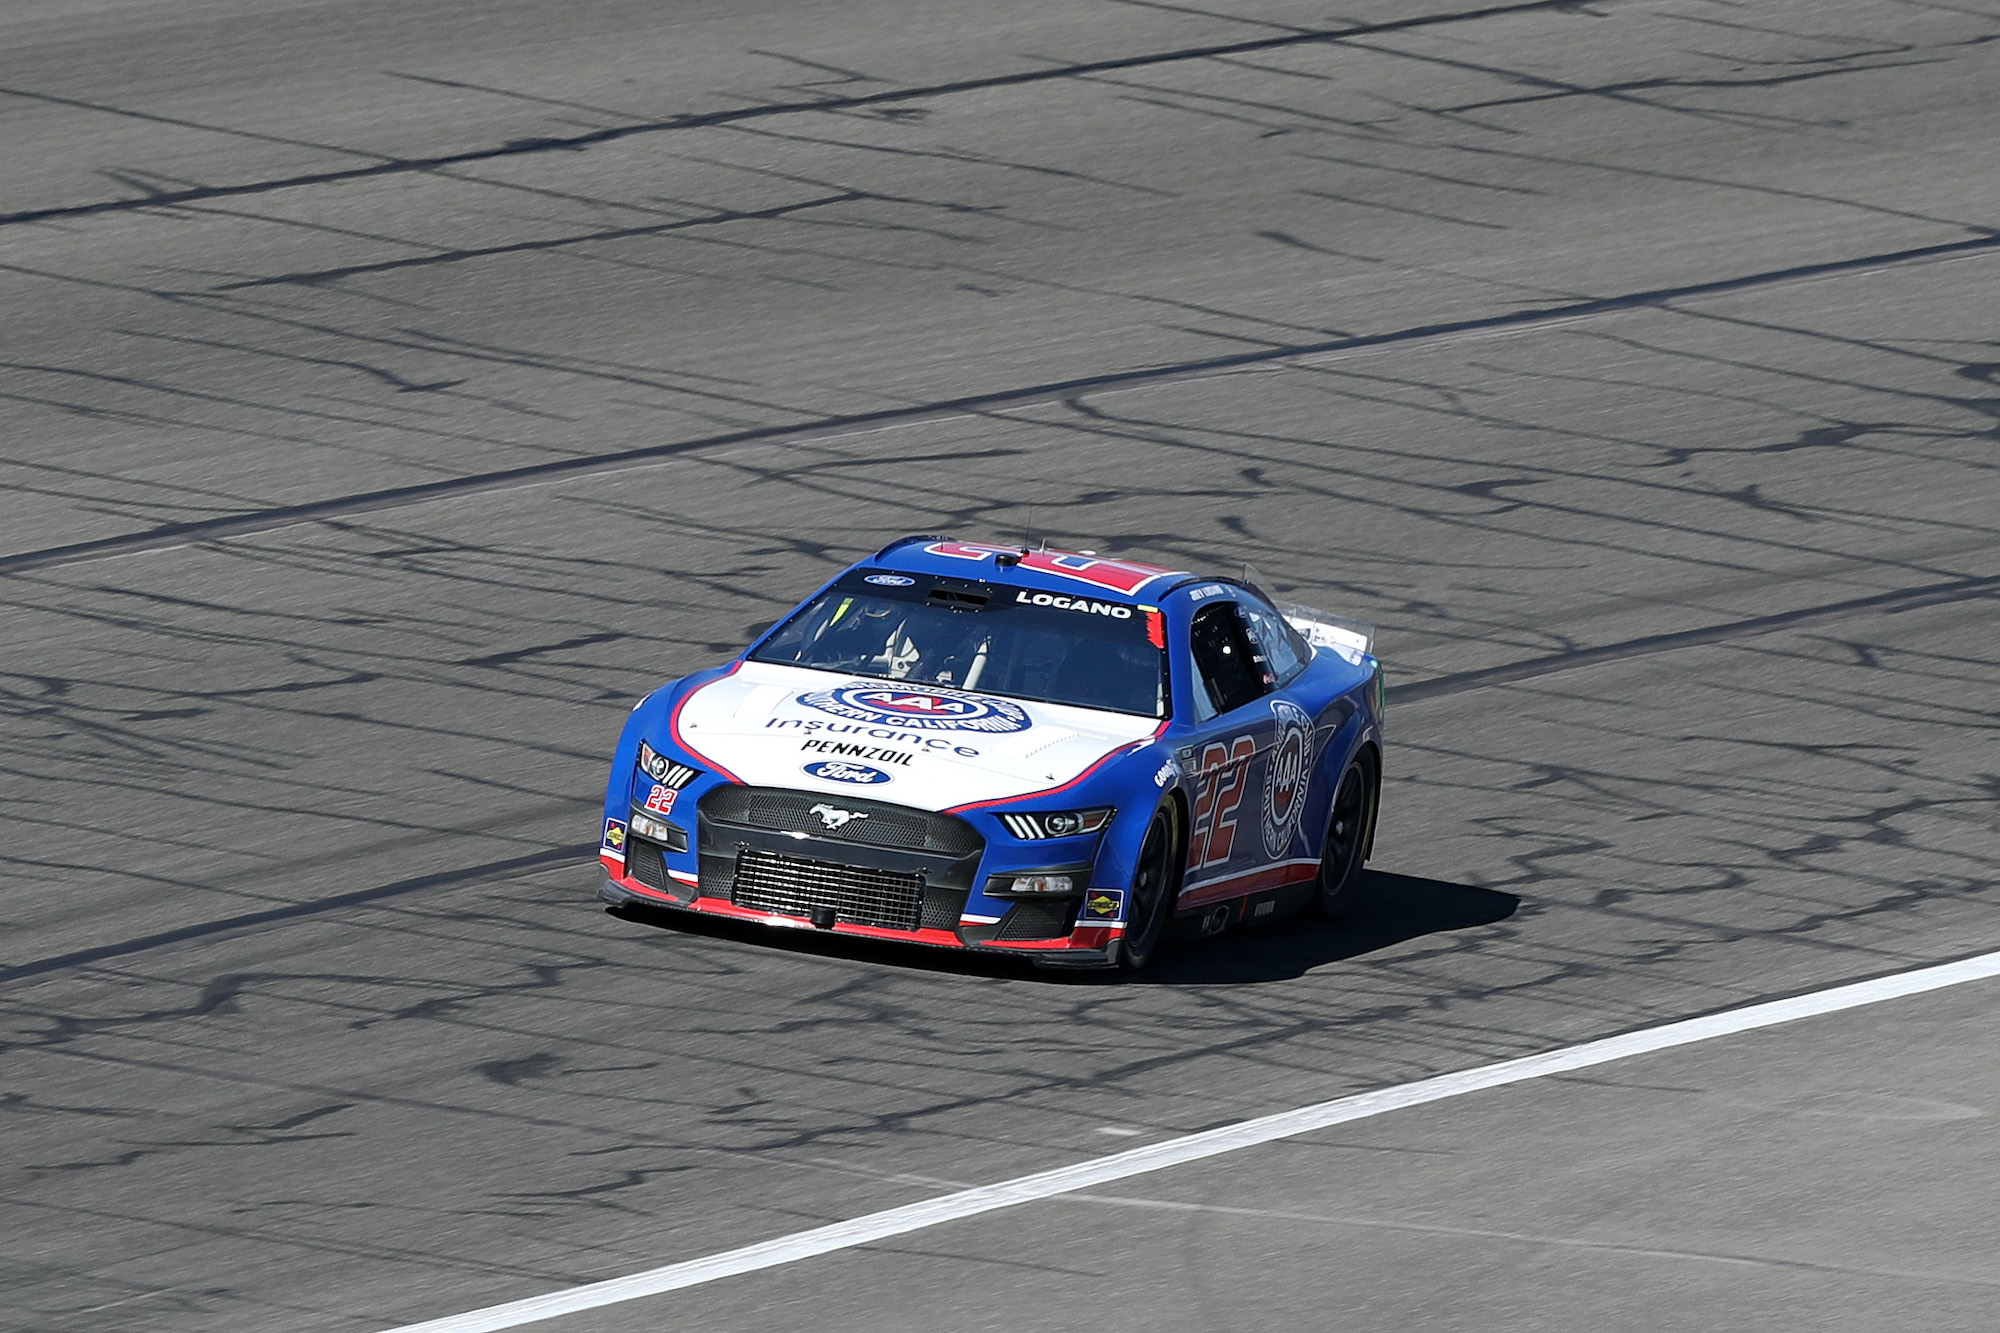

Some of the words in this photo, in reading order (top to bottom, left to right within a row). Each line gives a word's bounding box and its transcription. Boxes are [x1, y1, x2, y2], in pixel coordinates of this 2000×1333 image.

[1016, 590, 1132, 619] LOGANO
[861, 692, 965, 713] AAA
[800, 739, 914, 767] PENNZOIL
[814, 762, 877, 784] Ford
[1275, 752, 1299, 793] AAA
[644, 784, 678, 815] 22
[1184, 735, 1255, 876] 22
